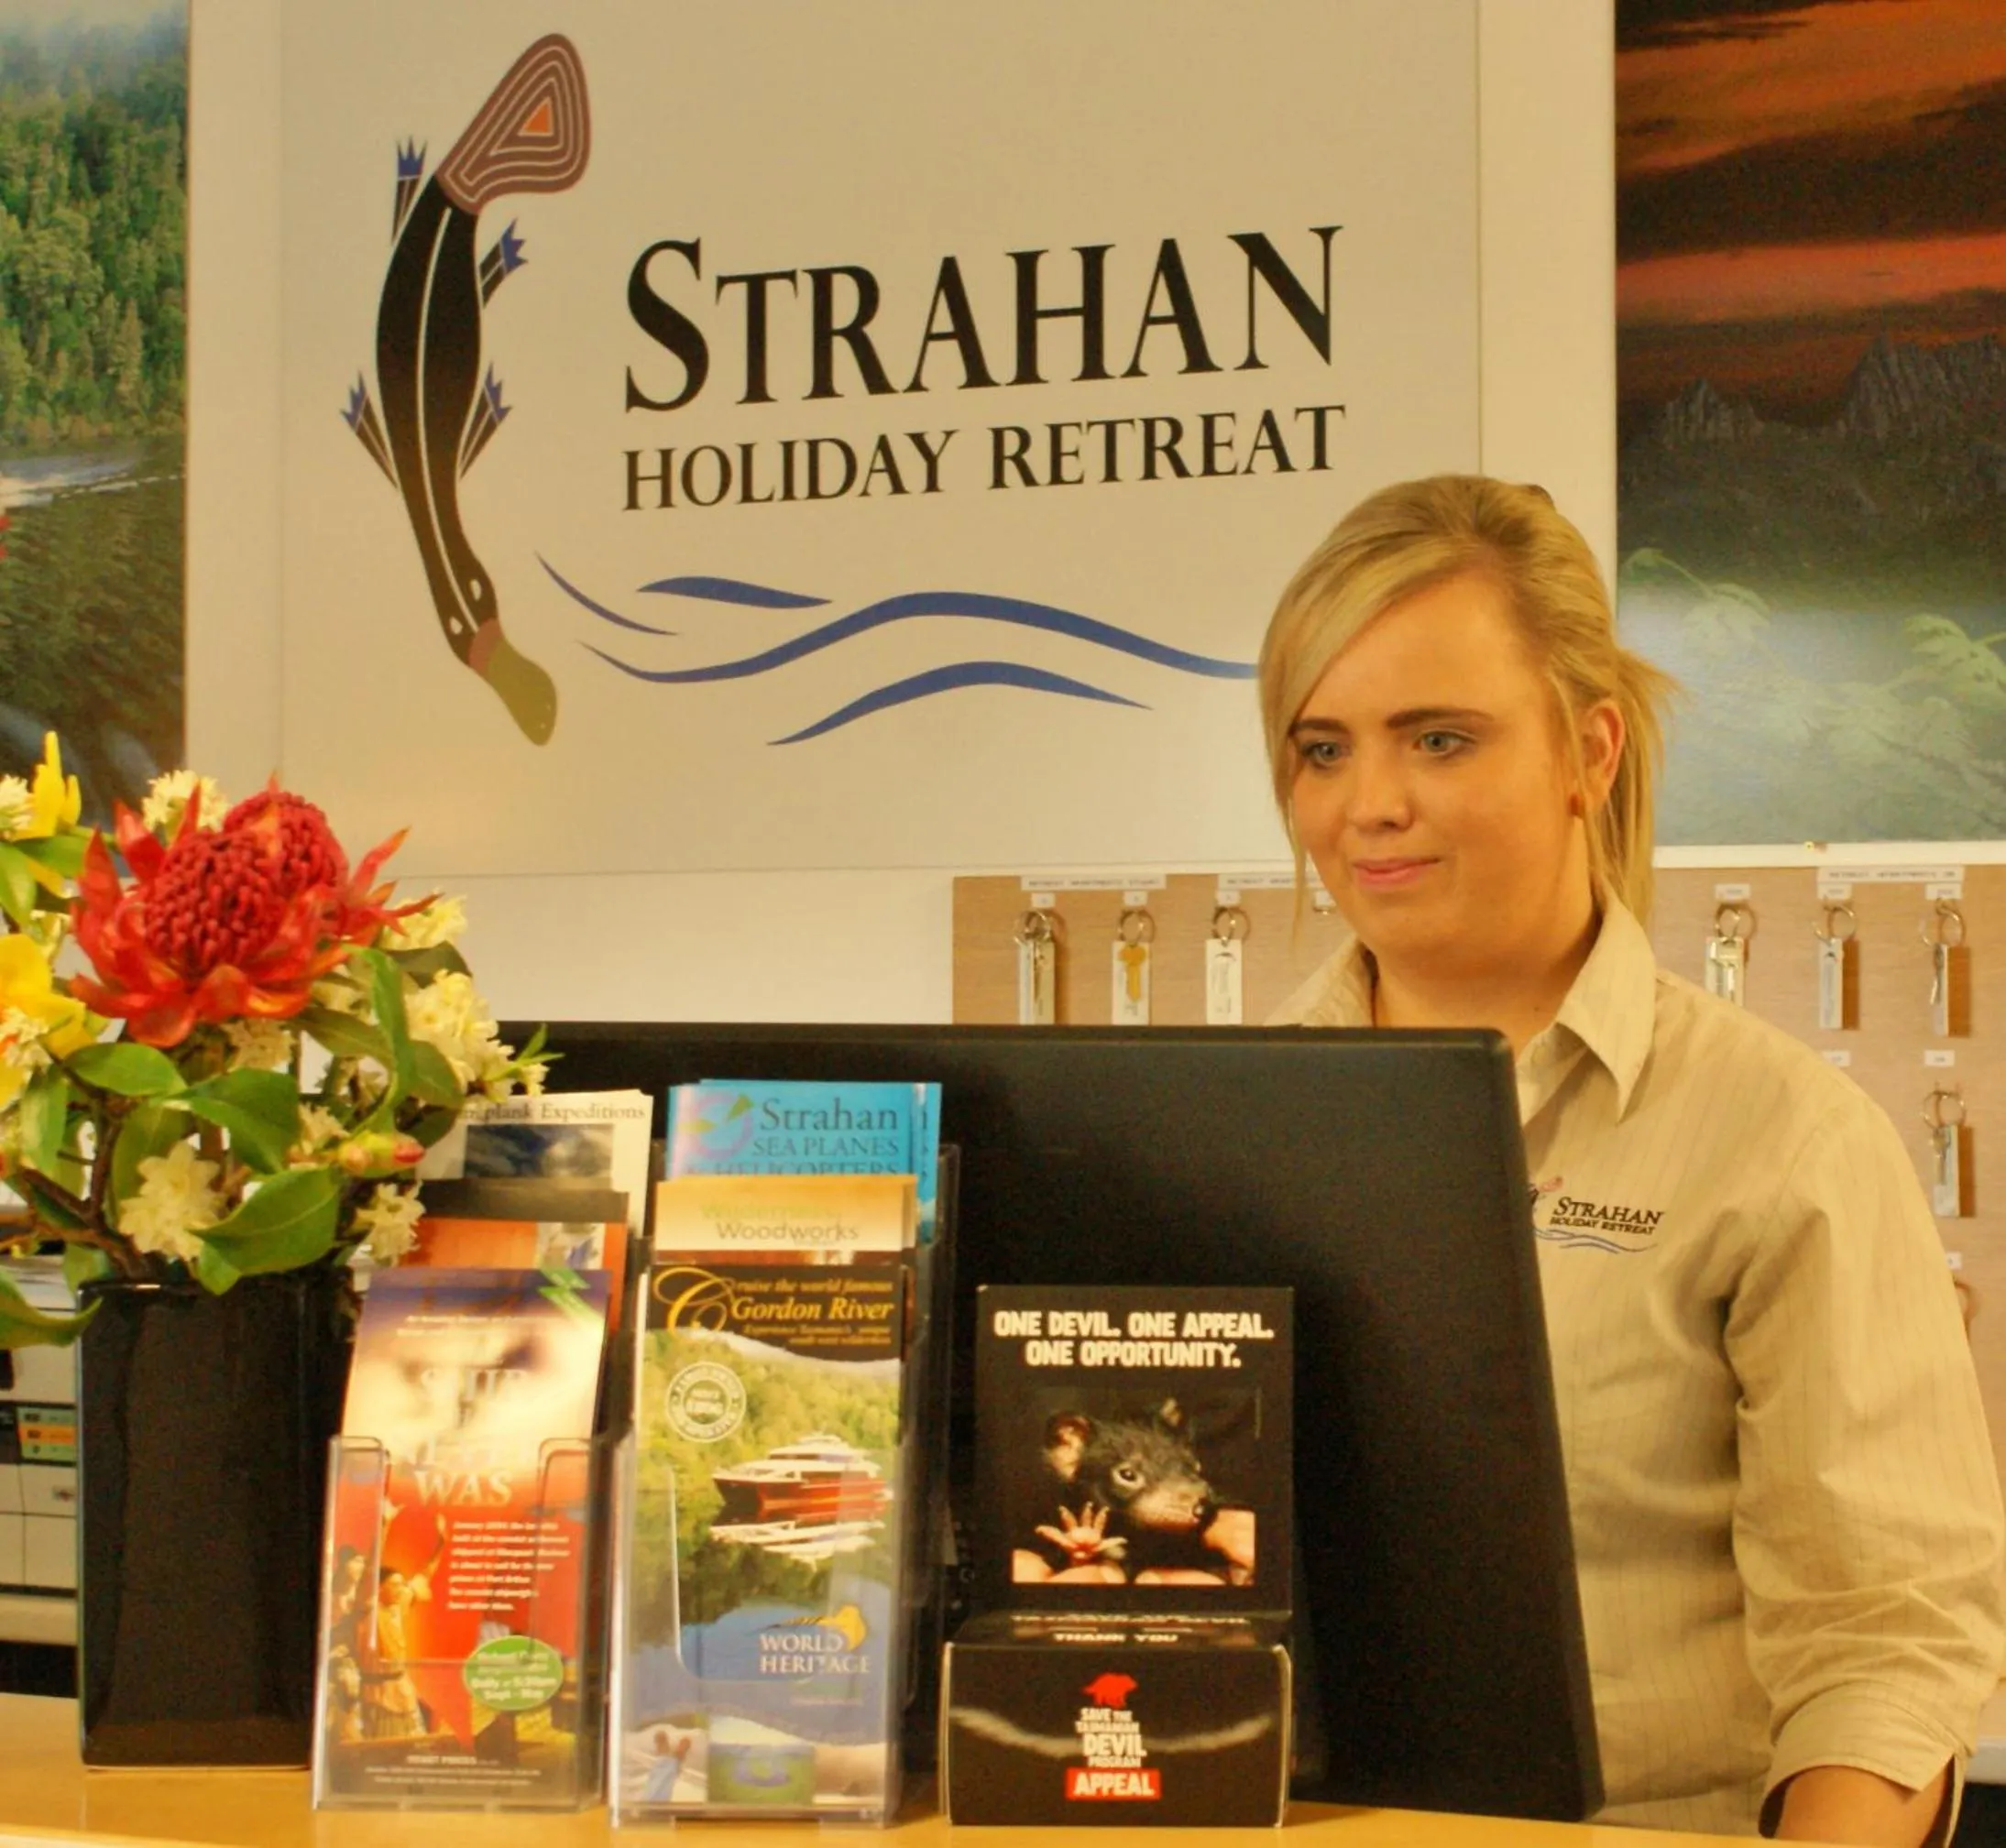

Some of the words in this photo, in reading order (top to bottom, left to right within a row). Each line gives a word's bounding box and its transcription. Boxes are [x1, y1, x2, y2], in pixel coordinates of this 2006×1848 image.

[625, 226, 1344, 414] STRAHAN
[622, 429, 960, 511] HOLIDAY
[987, 405, 1347, 490] RETREAT
[541, 1103, 645, 1121] Expeditions
[760, 1098, 898, 1131] Strahan
[1552, 1196, 1665, 1225] STRAHAN
[716, 1221, 860, 1241] Woodworks
[1550, 1216, 1599, 1229] HOLIDAY
[1601, 1221, 1656, 1235] RETREAT
[732, 1296, 821, 1320] Gordon
[828, 1296, 895, 1319] River
[993, 1311, 1042, 1336] ONE
[1048, 1311, 1122, 1337] DEVIL.
[1128, 1312, 1177, 1338] ONE
[1182, 1313, 1275, 1339] APPEAL.
[1025, 1340, 1074, 1365] ONE
[1080, 1342, 1242, 1368] OPPORTUNITY.
[414, 1470, 513, 1507] WAS
[759, 1633, 843, 1652] WORLD
[1053, 1633, 1125, 1643] THANK
[1133, 1633, 1178, 1643] YOU
[759, 1656, 870, 1674] HERITAGE
[1080, 1707, 1112, 1722] SAVE
[1083, 1733, 1147, 1757] DEVIL
[1073, 1772, 1155, 1797] APPEAL
